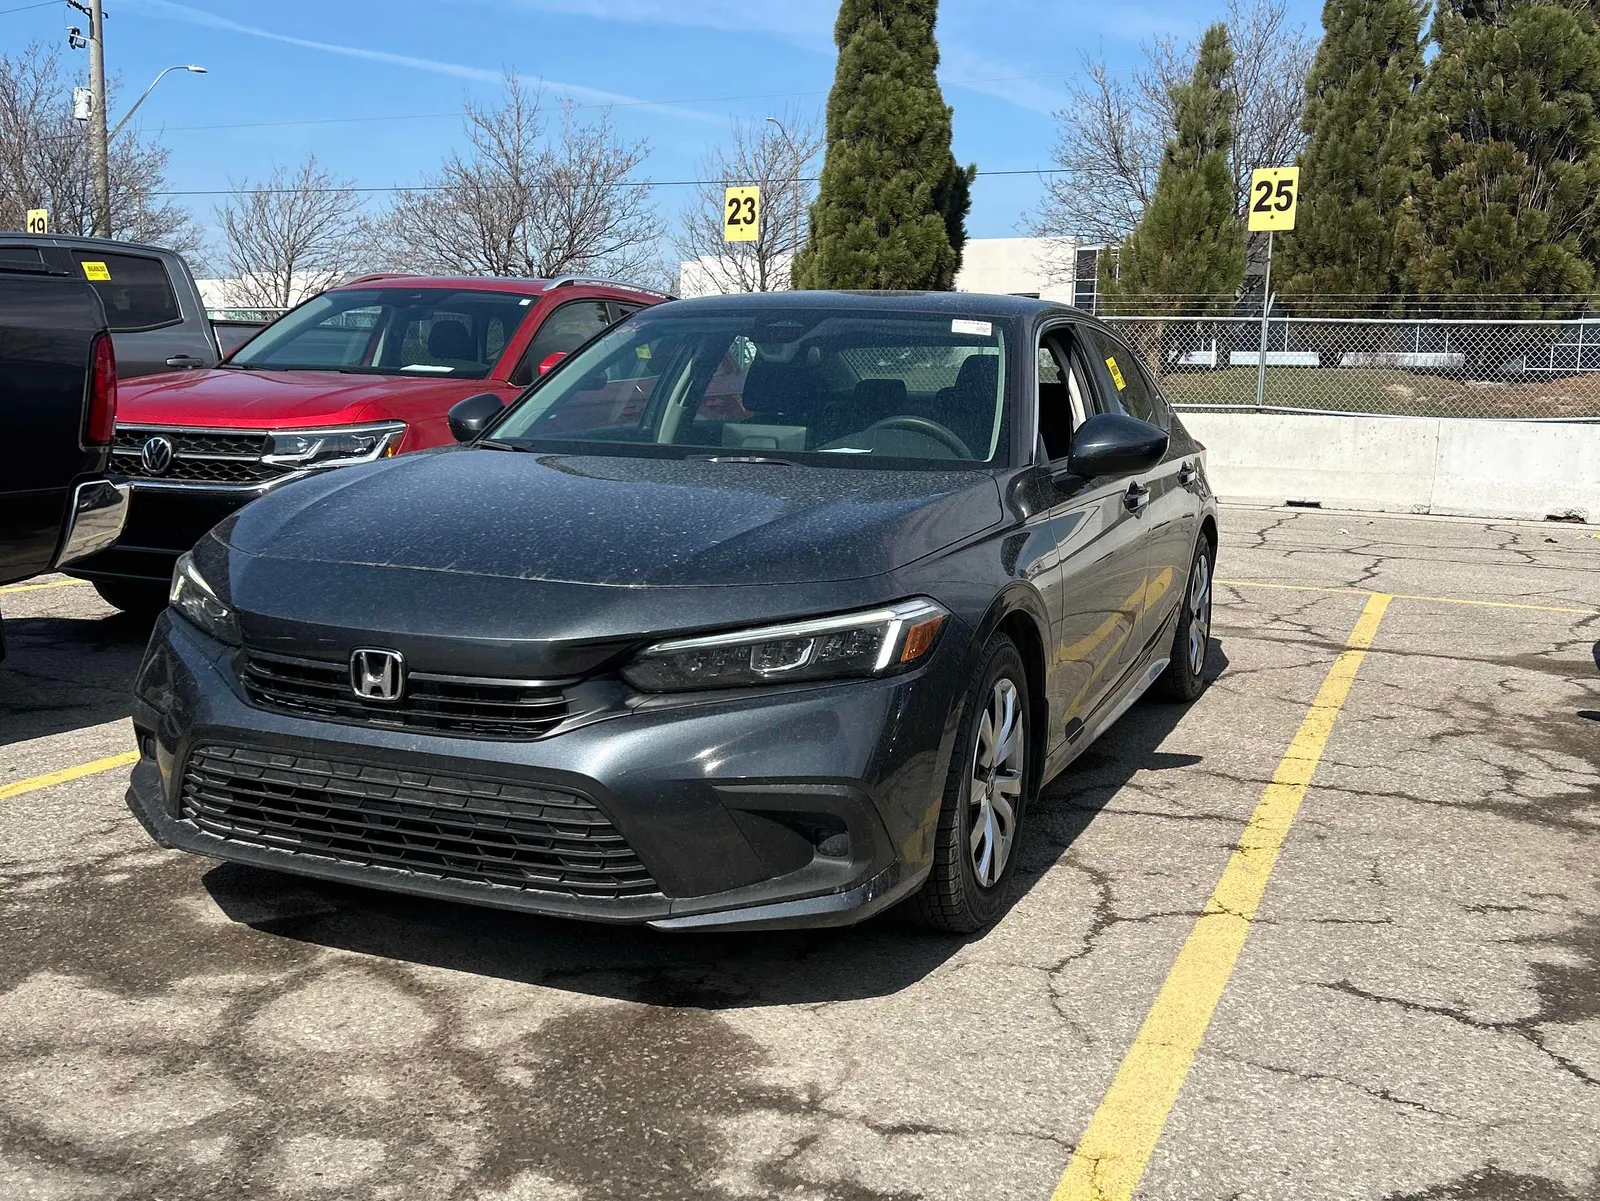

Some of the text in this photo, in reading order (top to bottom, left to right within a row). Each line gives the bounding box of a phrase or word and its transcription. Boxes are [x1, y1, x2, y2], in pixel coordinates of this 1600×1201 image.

[727, 196, 756, 226] 23
[1252, 179, 1294, 213] 25
[29, 217, 45, 234] 19
